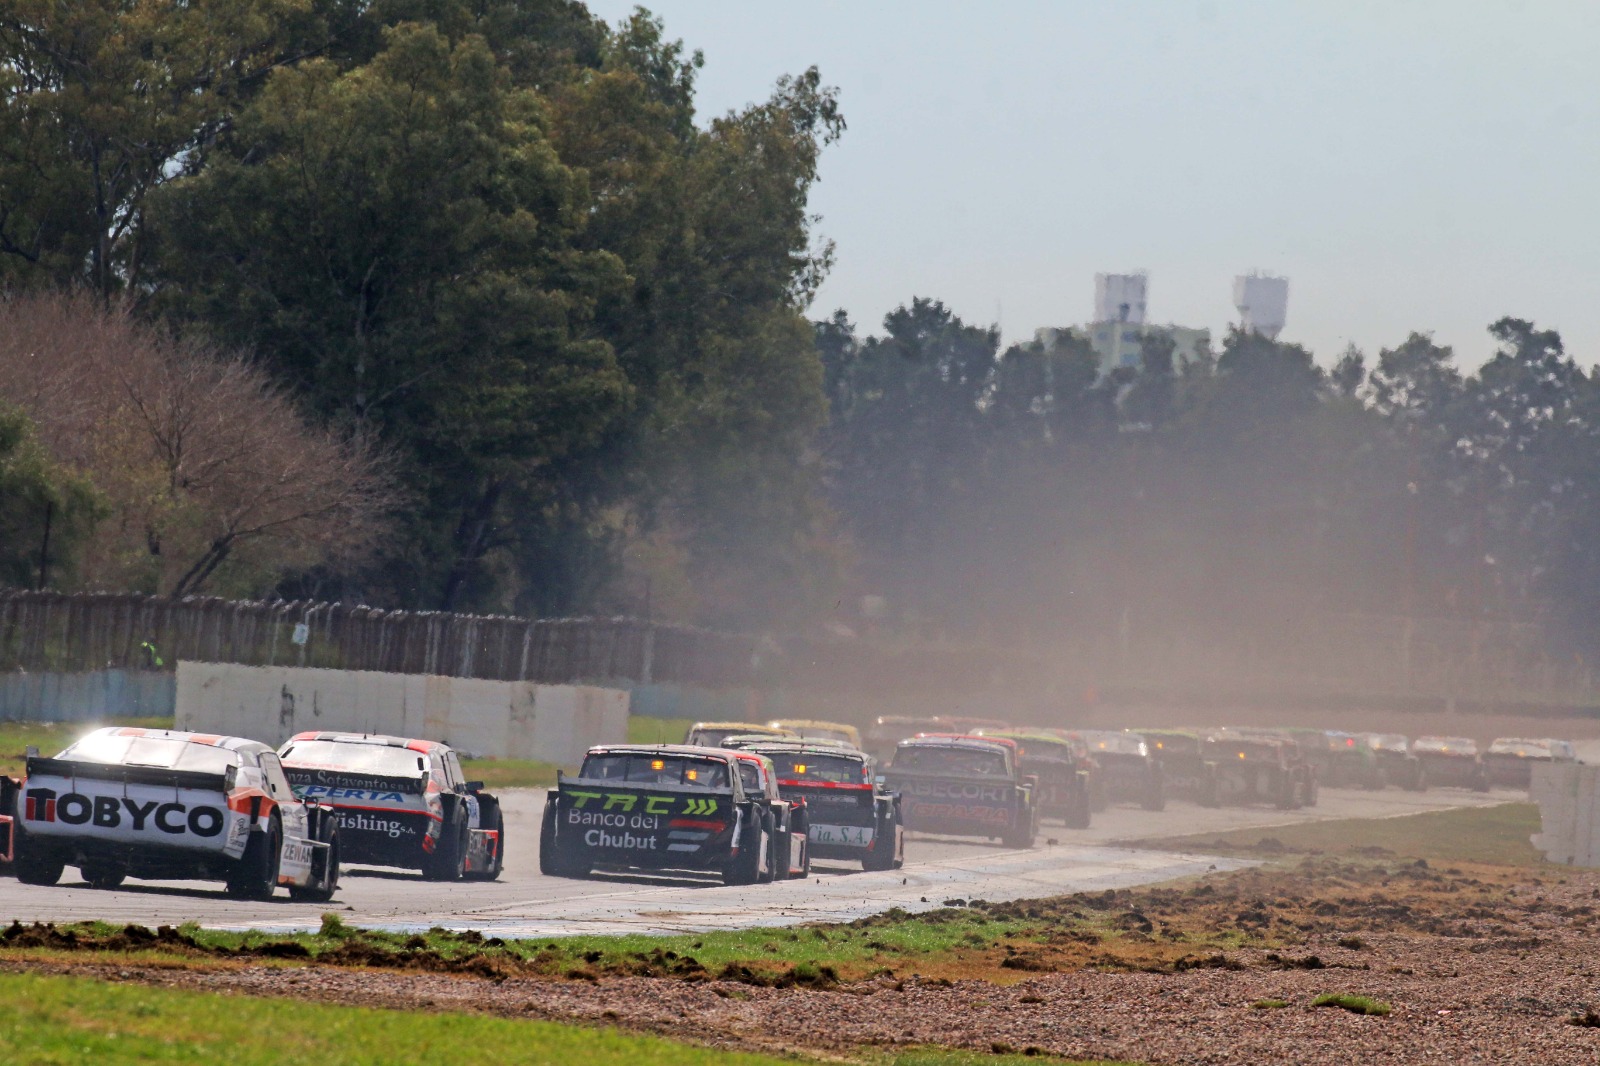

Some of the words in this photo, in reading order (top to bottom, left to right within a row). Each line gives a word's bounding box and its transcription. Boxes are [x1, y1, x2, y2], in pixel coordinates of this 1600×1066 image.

[25, 787, 224, 838] TOBYCO
[568, 807, 627, 827] Banco
[630, 808, 660, 829] del
[584, 829, 657, 850] Chubut
[839, 827, 868, 844] S.A.
